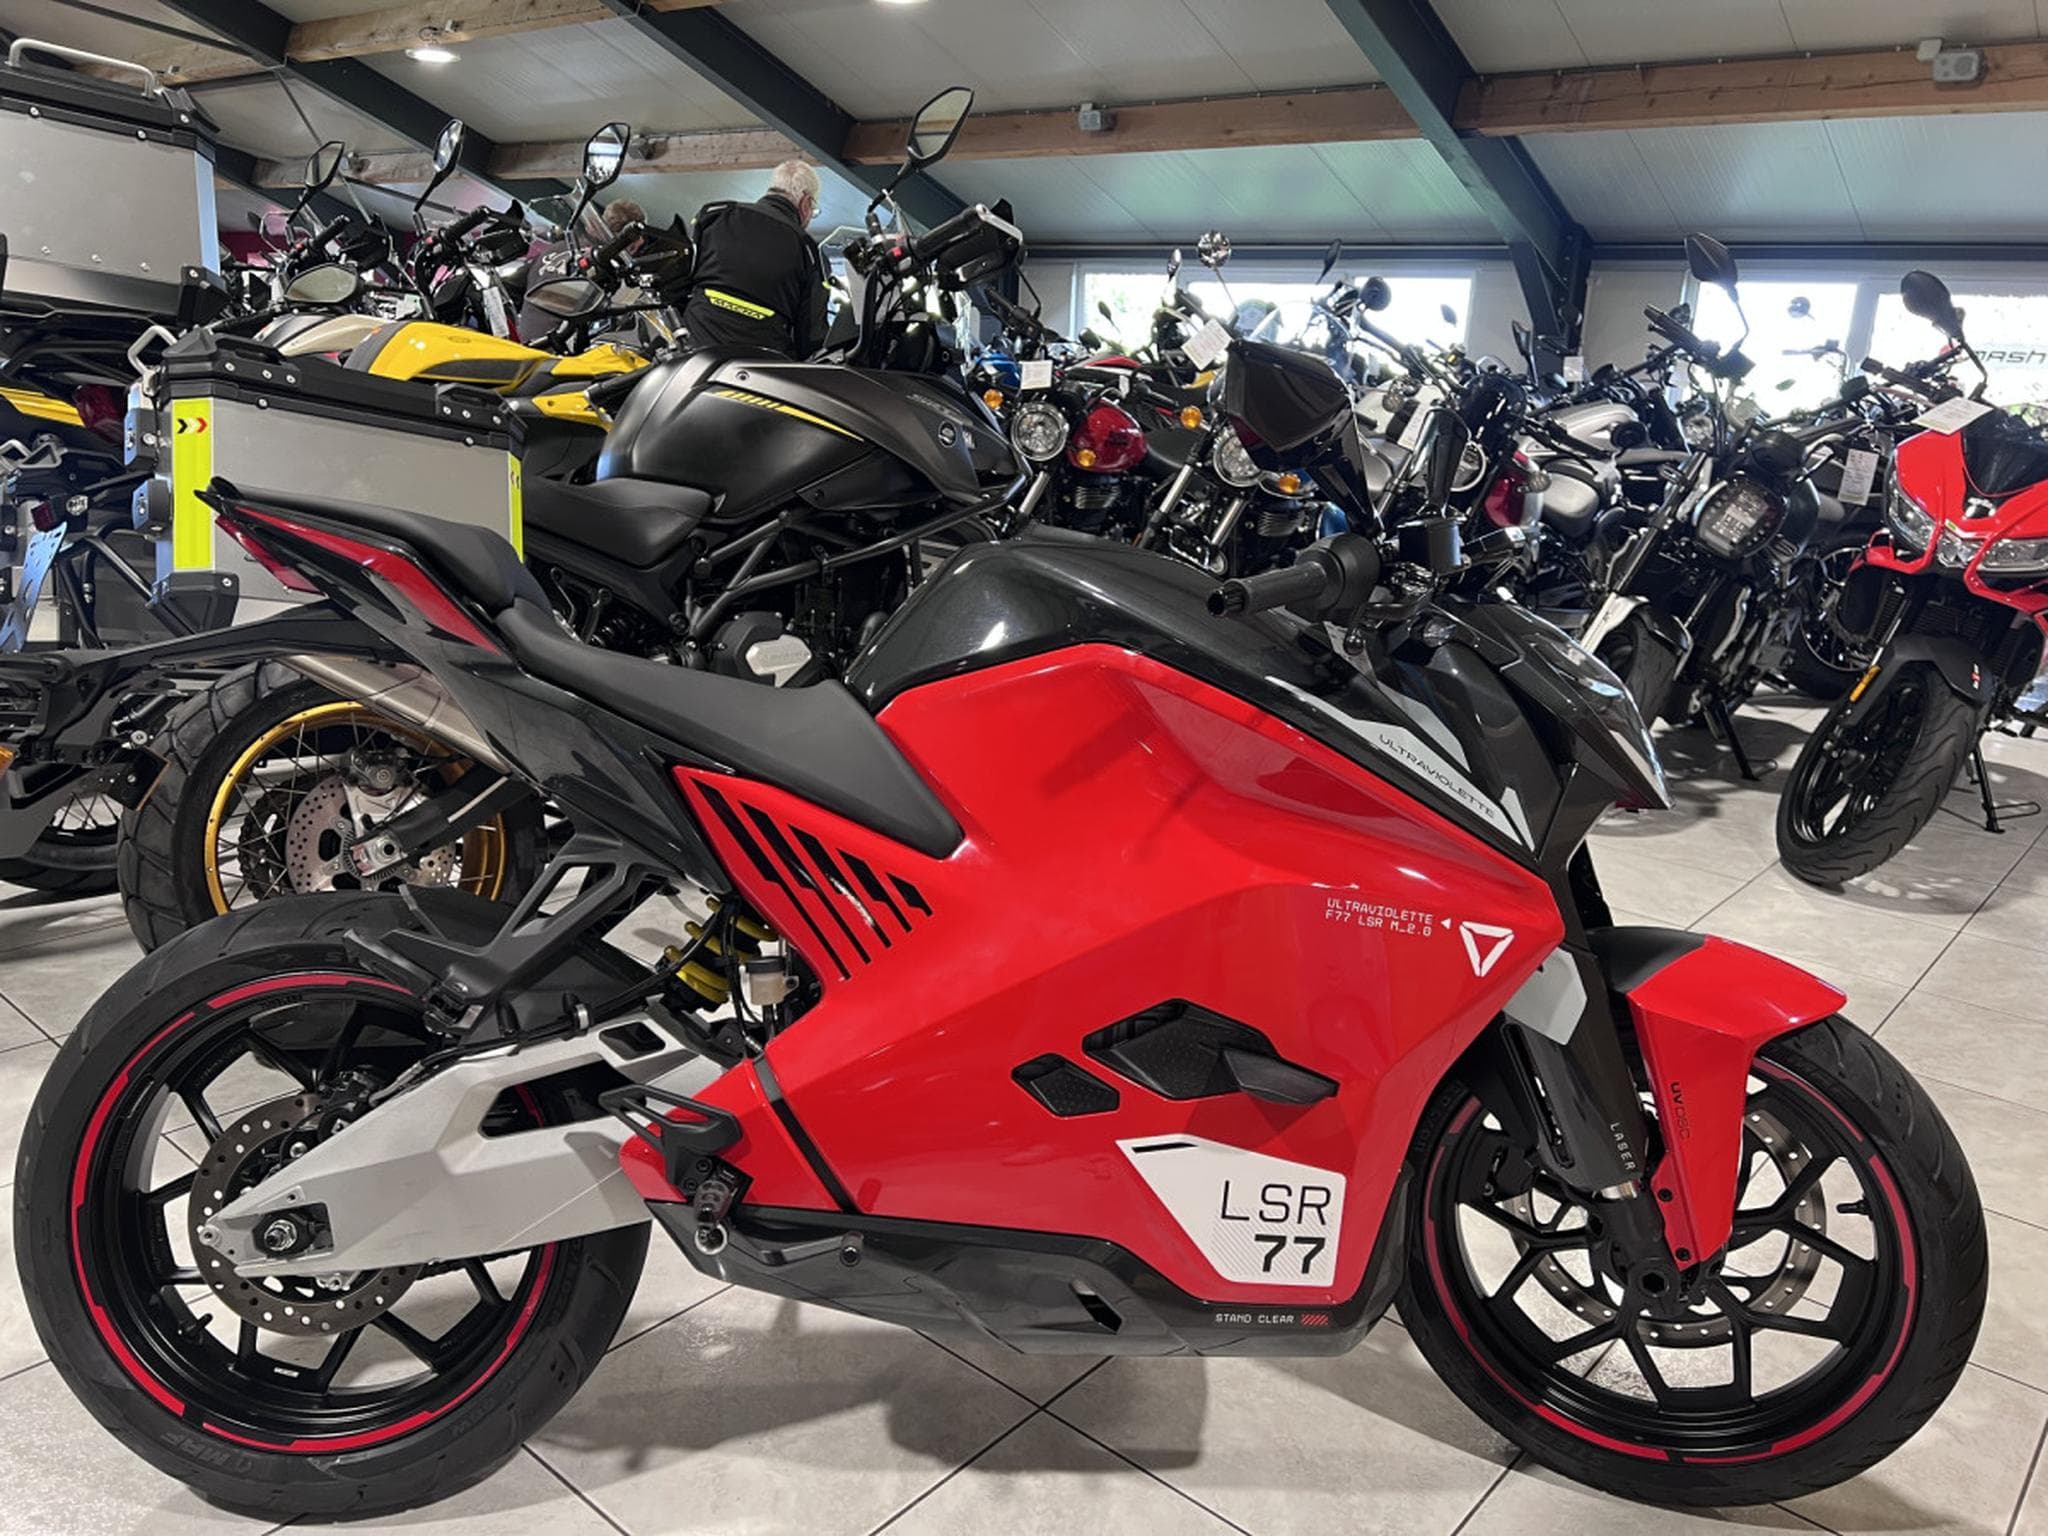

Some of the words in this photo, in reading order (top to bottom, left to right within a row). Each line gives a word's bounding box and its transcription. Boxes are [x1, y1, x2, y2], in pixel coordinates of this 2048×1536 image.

[1378, 733, 1496, 819] ULTRAVIOLETTE
[1325, 909, 1351, 923] F77
[1358, 915, 1383, 929] LSR
[1327, 897, 1433, 925] ULTRAVIOLETTE
[1609, 1121, 1636, 1170] LASER
[1221, 1180, 1331, 1226] LSR
[1254, 1233, 1326, 1275] 77
[1215, 1313, 1251, 1324] STAND
[1257, 1314, 1295, 1325] CLEAR
